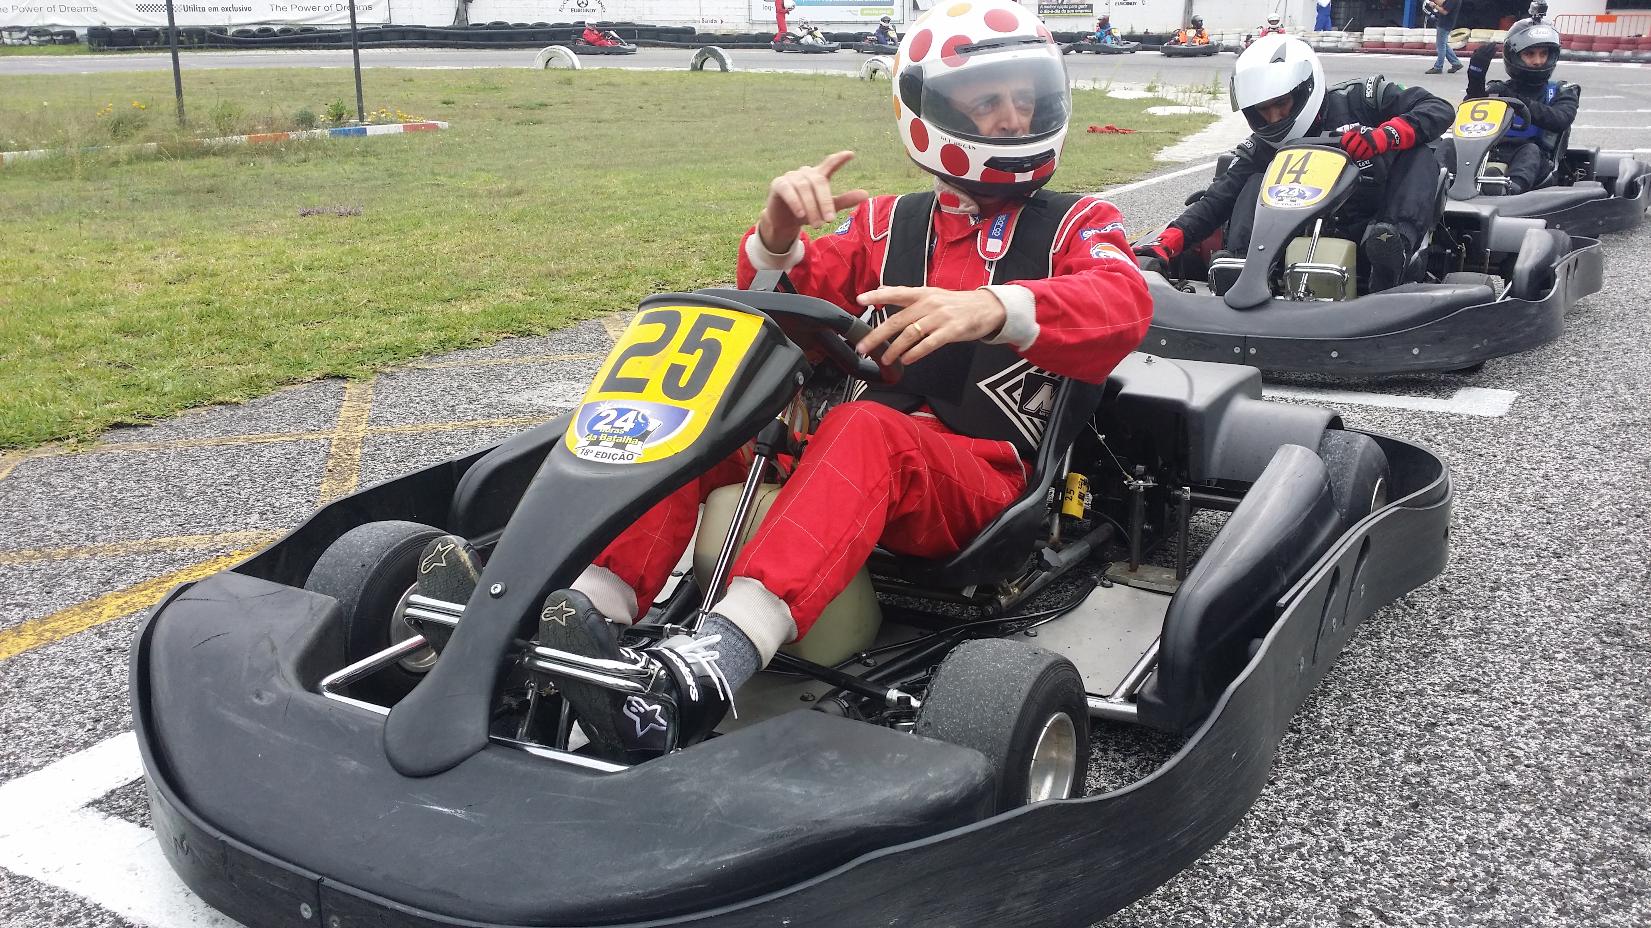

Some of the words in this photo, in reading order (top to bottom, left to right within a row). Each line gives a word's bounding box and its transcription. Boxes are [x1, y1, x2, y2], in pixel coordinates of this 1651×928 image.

[11, 4, 43, 13] Power
[46, 4, 56, 13] of
[59, 4, 98, 13] Dreams
[220, 3, 252, 12] exclusivo
[270, 3, 288, 12] The
[290, 3, 321, 12] Power
[323, 3, 333, 12] of
[1470, 101, 1490, 122] 6
[1274, 151, 1313, 185] 14
[598, 309, 736, 401] 25
[592, 408, 638, 432] 24
[585, 433, 597, 442] da
[599, 433, 639, 446] Batalha
[594, 450, 634, 461] EDIÇÃO
